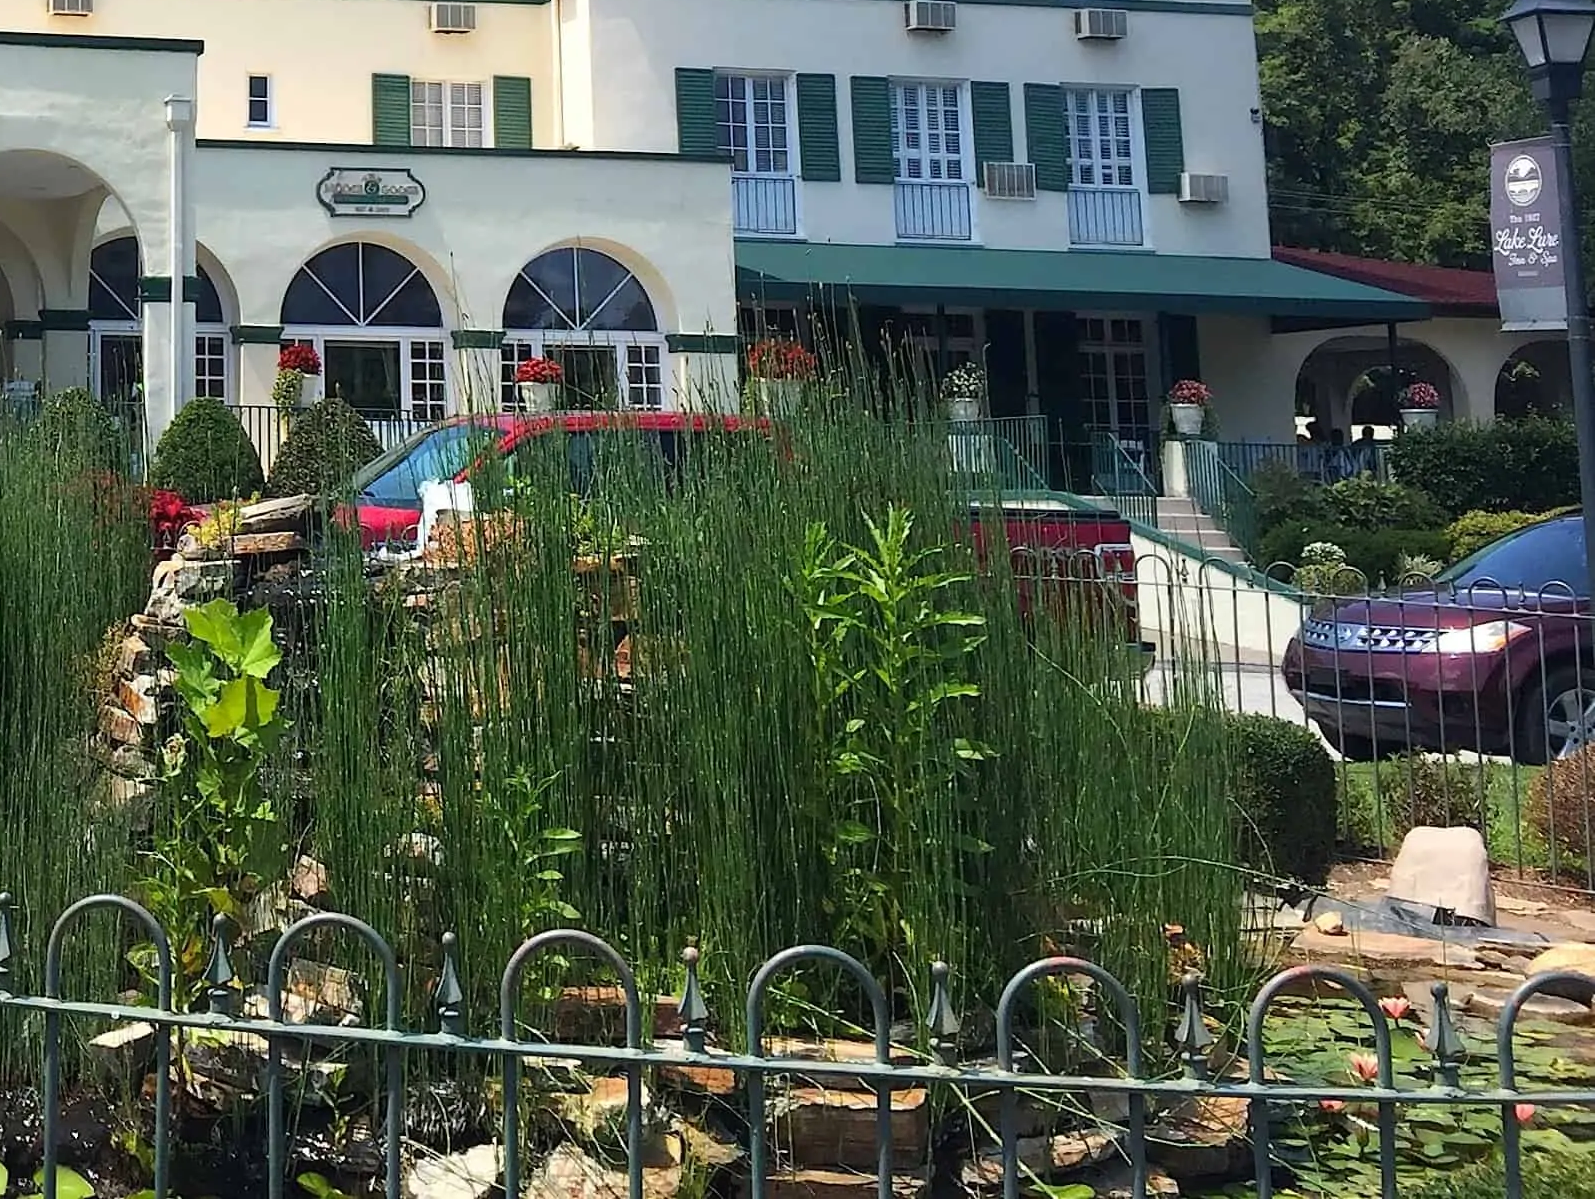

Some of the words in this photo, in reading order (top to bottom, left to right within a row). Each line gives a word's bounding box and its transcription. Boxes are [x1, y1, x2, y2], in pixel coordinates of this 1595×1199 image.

[1494, 227, 1527, 255] Lake
[1527, 225, 1559, 254] Lure
[1508, 252, 1526, 266] Inn
[1527, 251, 1538, 264] &
[1540, 250, 1558, 268] Spa
